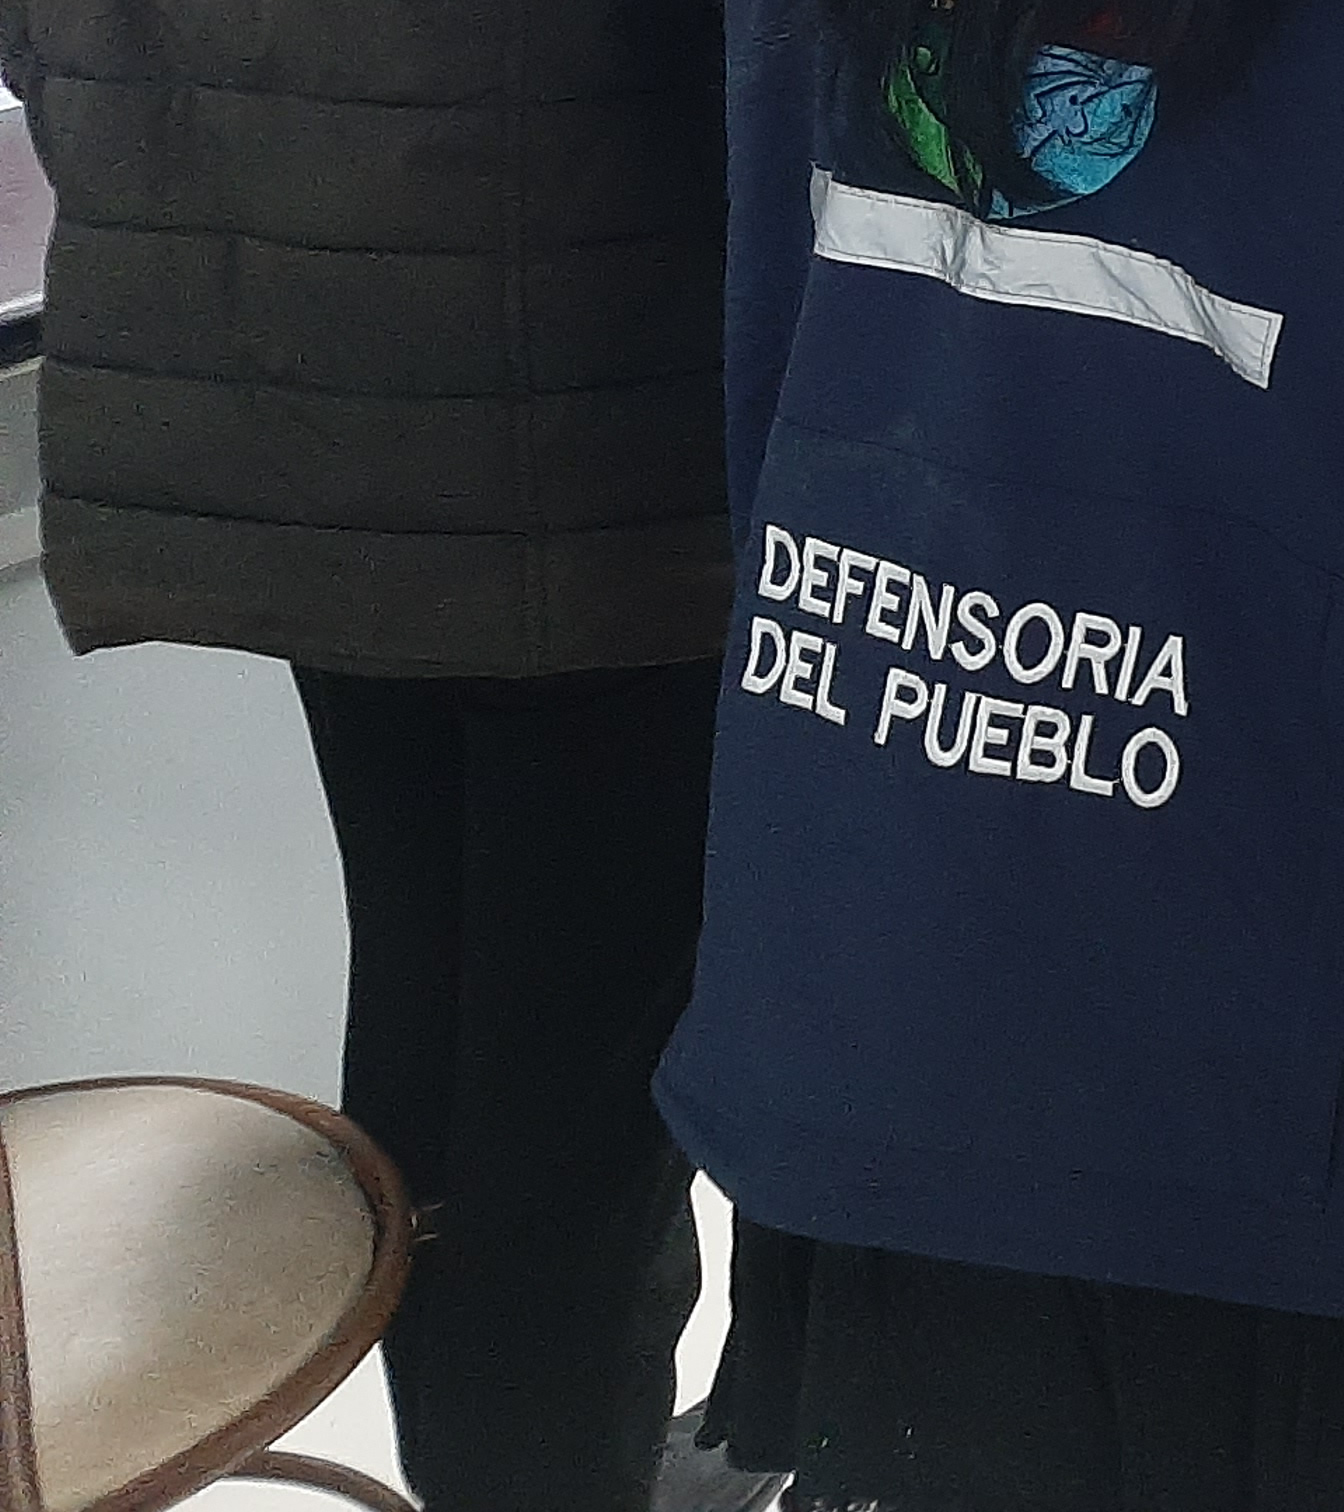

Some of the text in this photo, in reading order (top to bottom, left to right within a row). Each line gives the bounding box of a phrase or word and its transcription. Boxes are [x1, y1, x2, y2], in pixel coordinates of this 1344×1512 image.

[740, 616, 1180, 809] DEL PUEBLO
[757, 523, 1189, 717] DEFENSORIA
